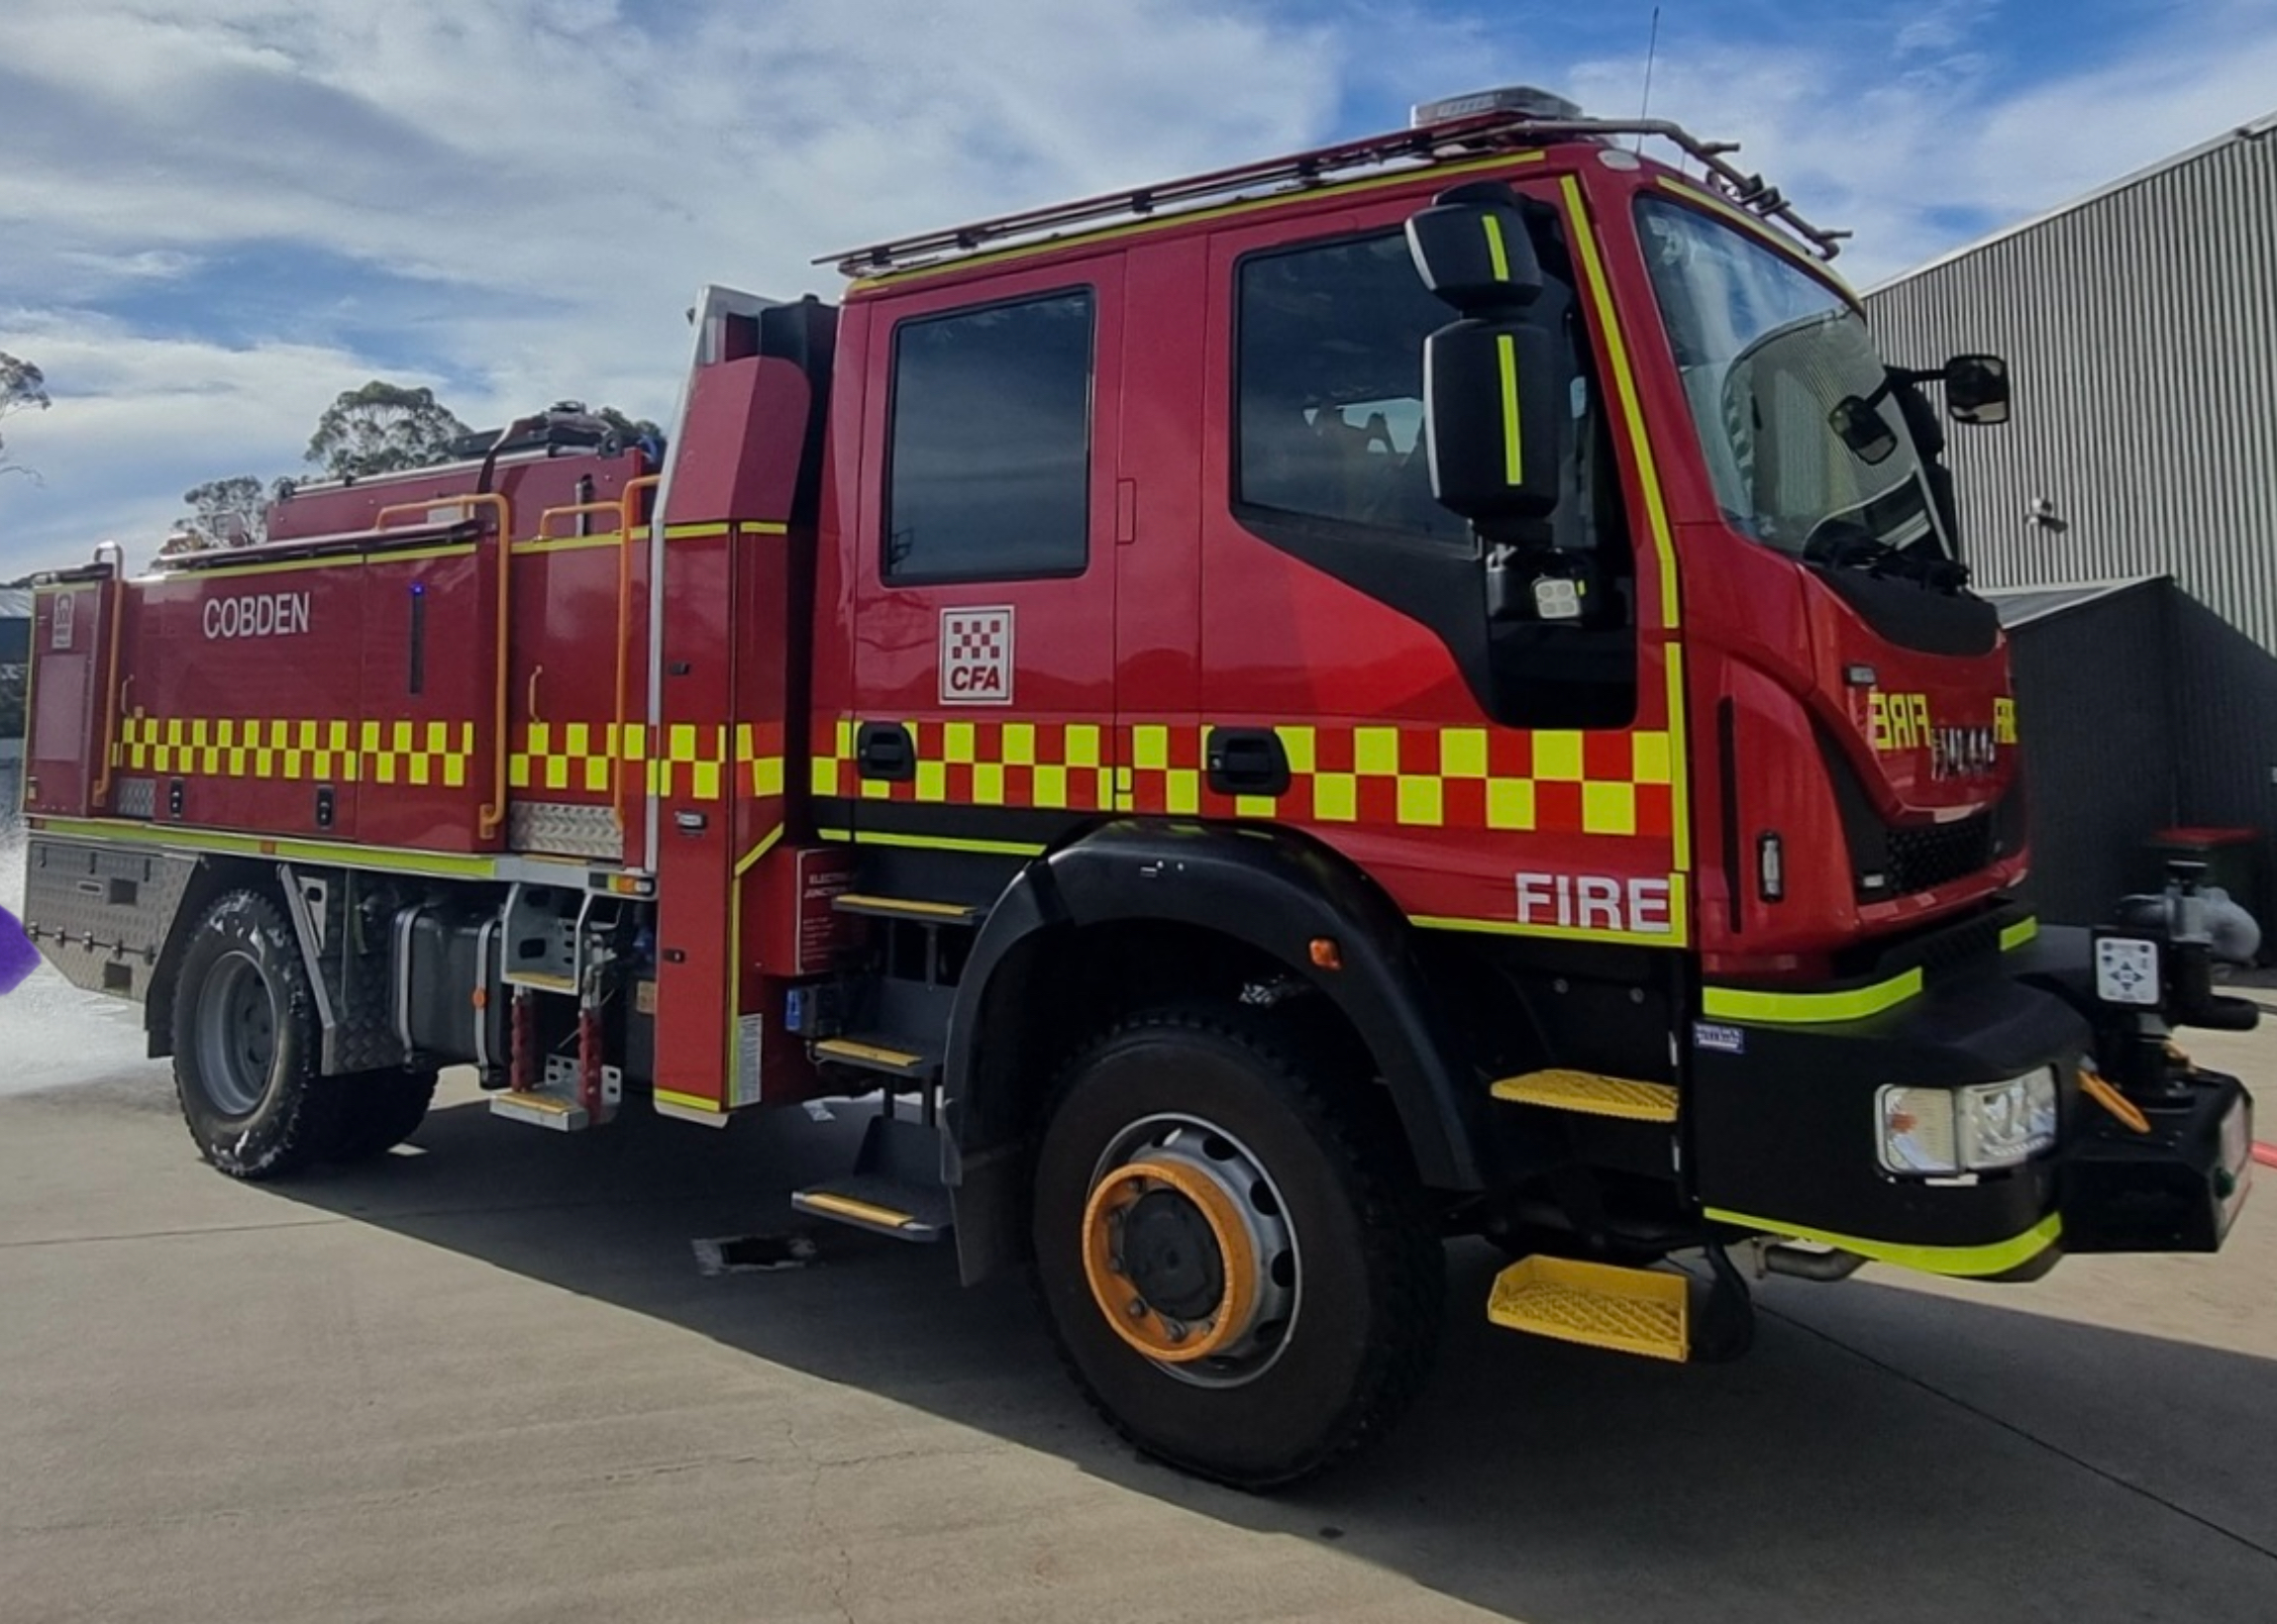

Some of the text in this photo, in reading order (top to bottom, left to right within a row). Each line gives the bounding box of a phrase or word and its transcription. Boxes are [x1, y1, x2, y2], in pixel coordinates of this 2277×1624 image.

[203, 591, 310, 639] COBDEN
[951, 665, 1000, 691] CFA
[1515, 871, 1672, 933] FIRE
